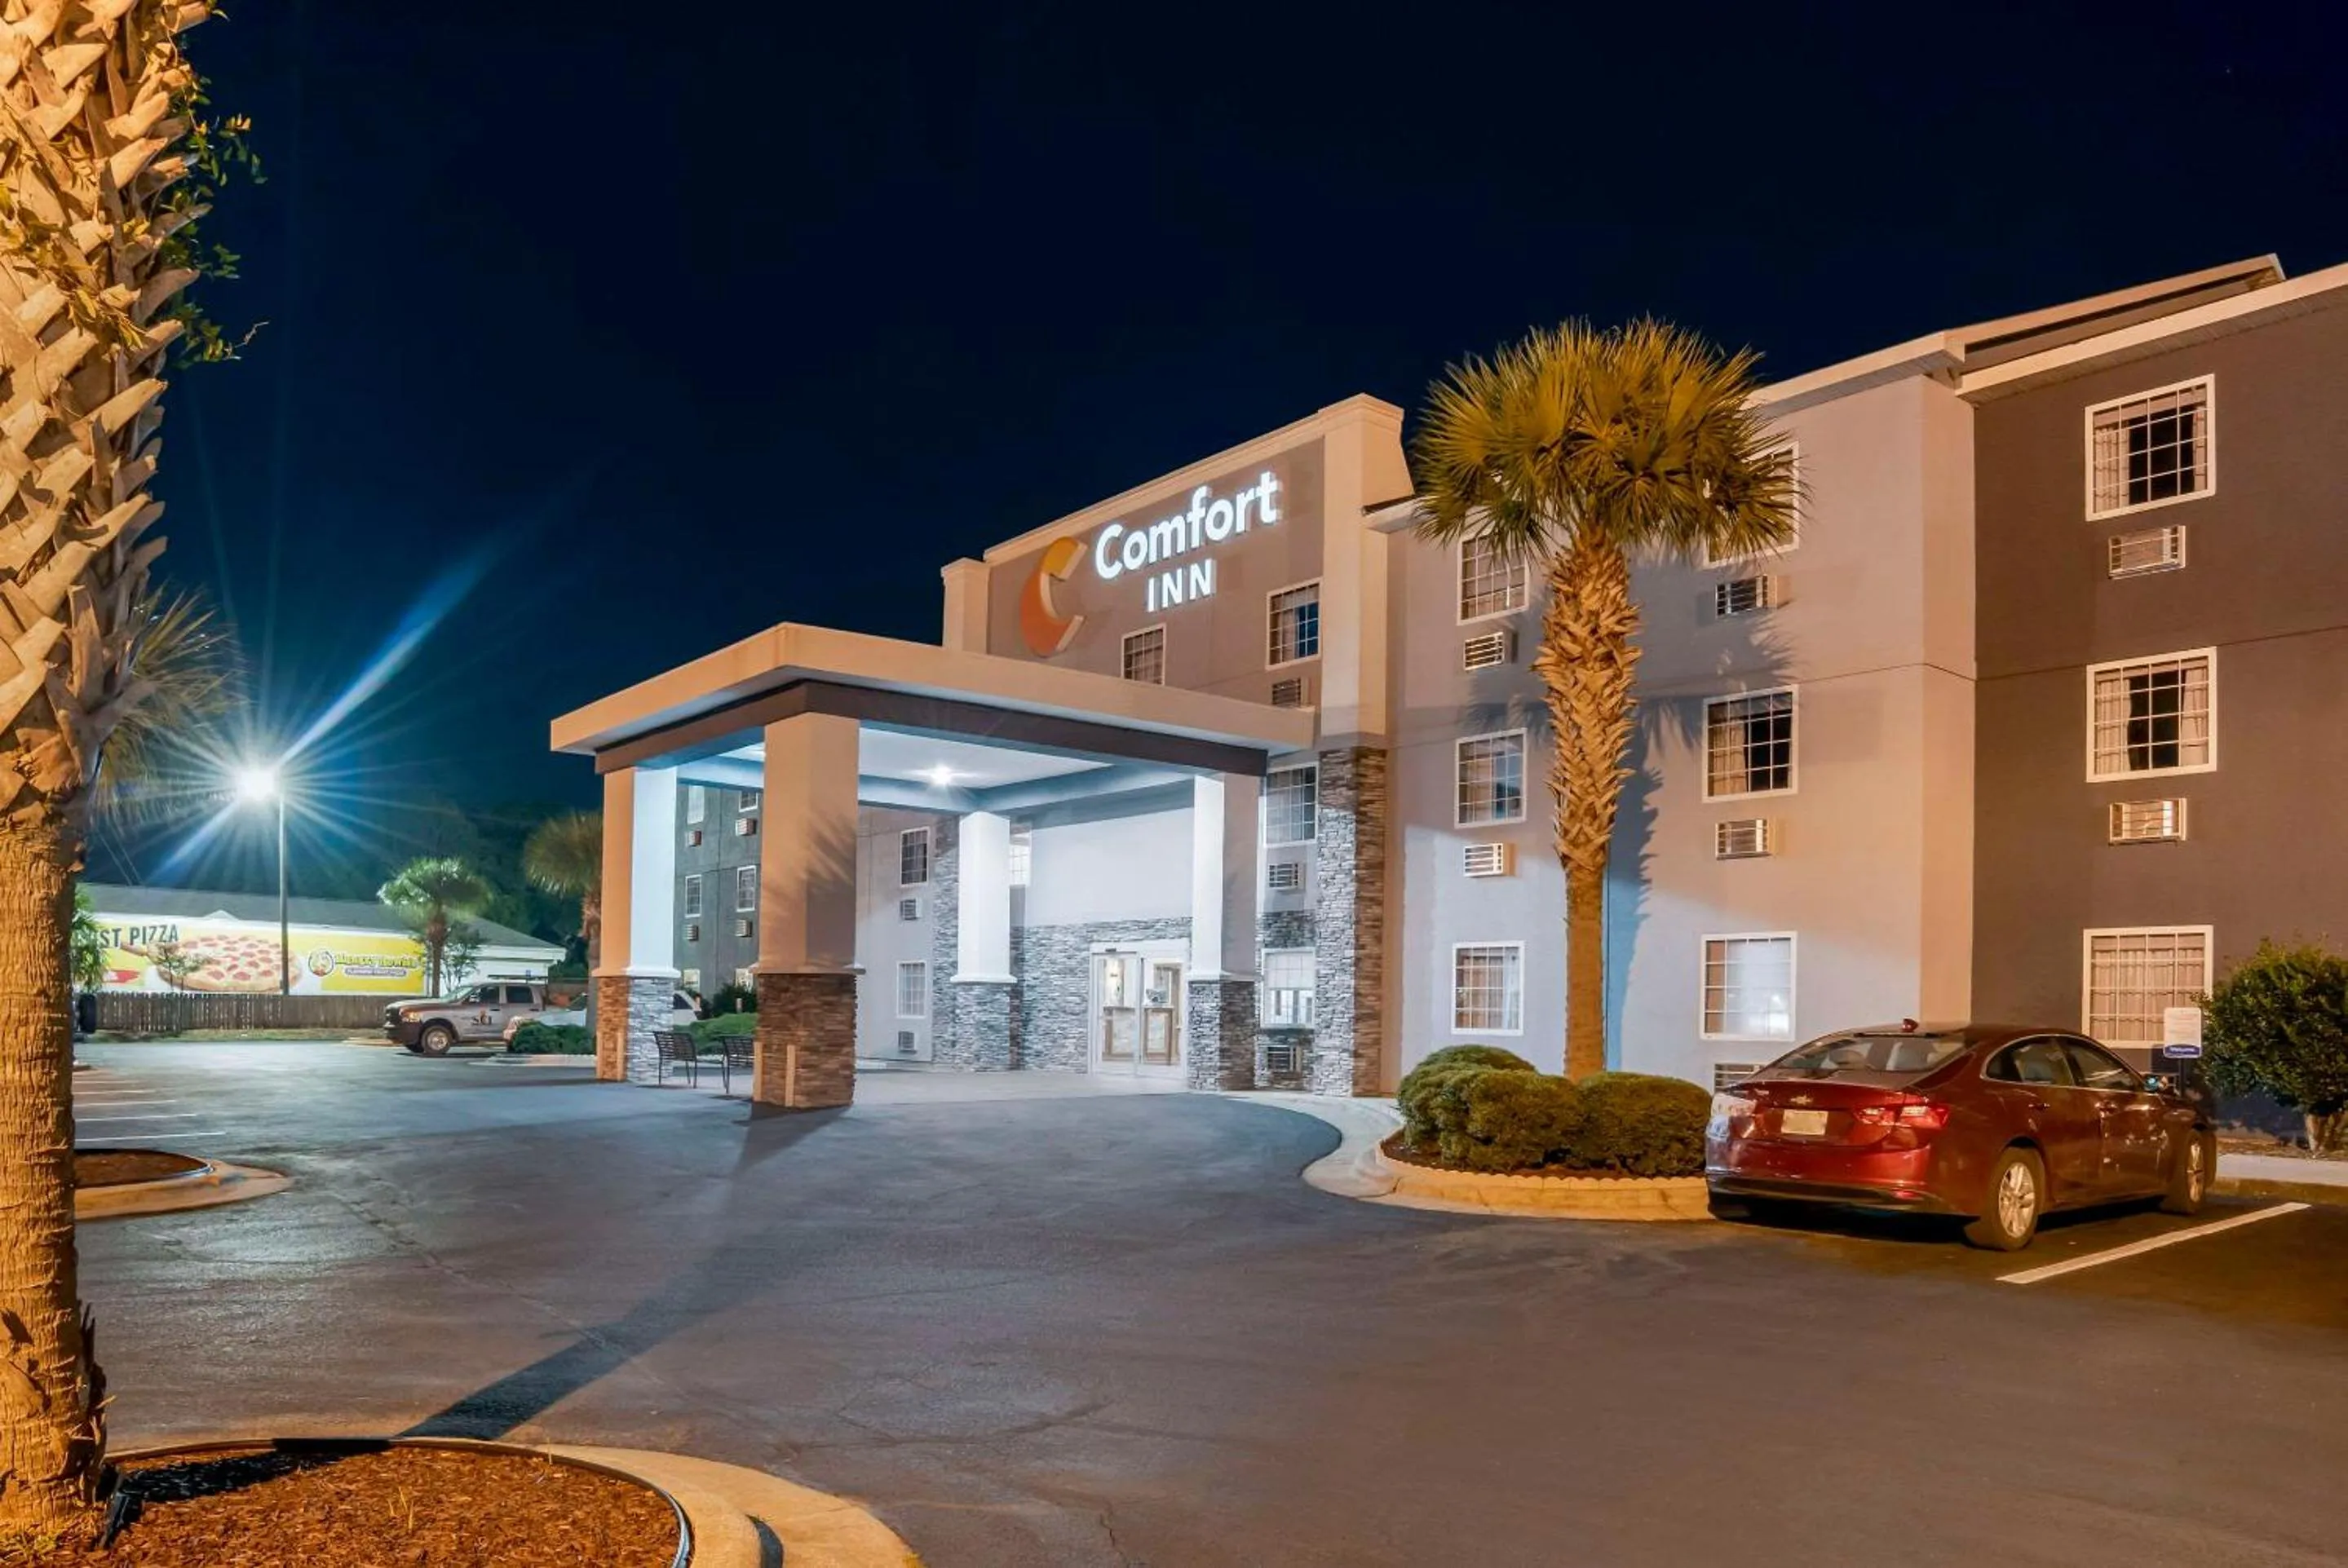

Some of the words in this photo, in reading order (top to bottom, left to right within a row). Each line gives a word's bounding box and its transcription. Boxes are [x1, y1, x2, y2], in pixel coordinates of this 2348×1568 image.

[1094, 470, 1282, 580] Comfort
[1145, 558, 1216, 613] INN
[129, 924, 179, 946] PIZZA
